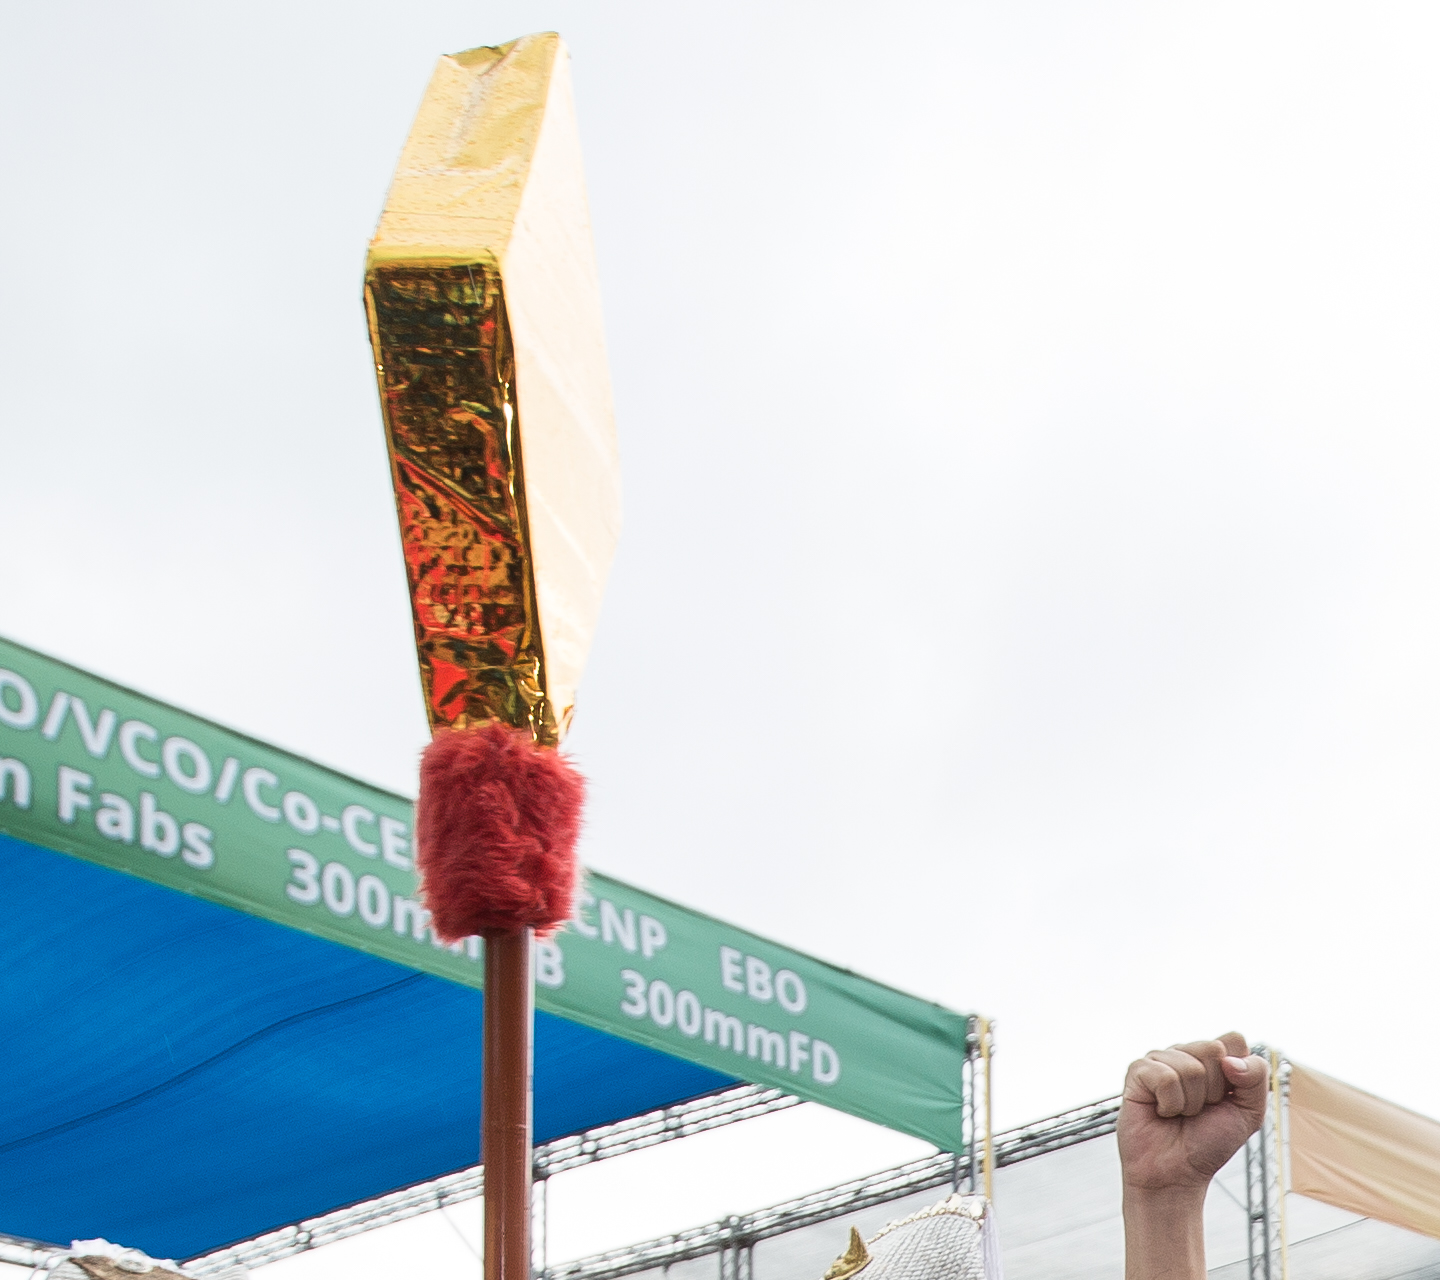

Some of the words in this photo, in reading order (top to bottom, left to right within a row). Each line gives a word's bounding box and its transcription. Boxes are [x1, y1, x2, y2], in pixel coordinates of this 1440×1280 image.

[58, 766, 215, 868] Fabs
[620, 968, 843, 1086] 300mmFD
[719, 945, 808, 1015] EBO
